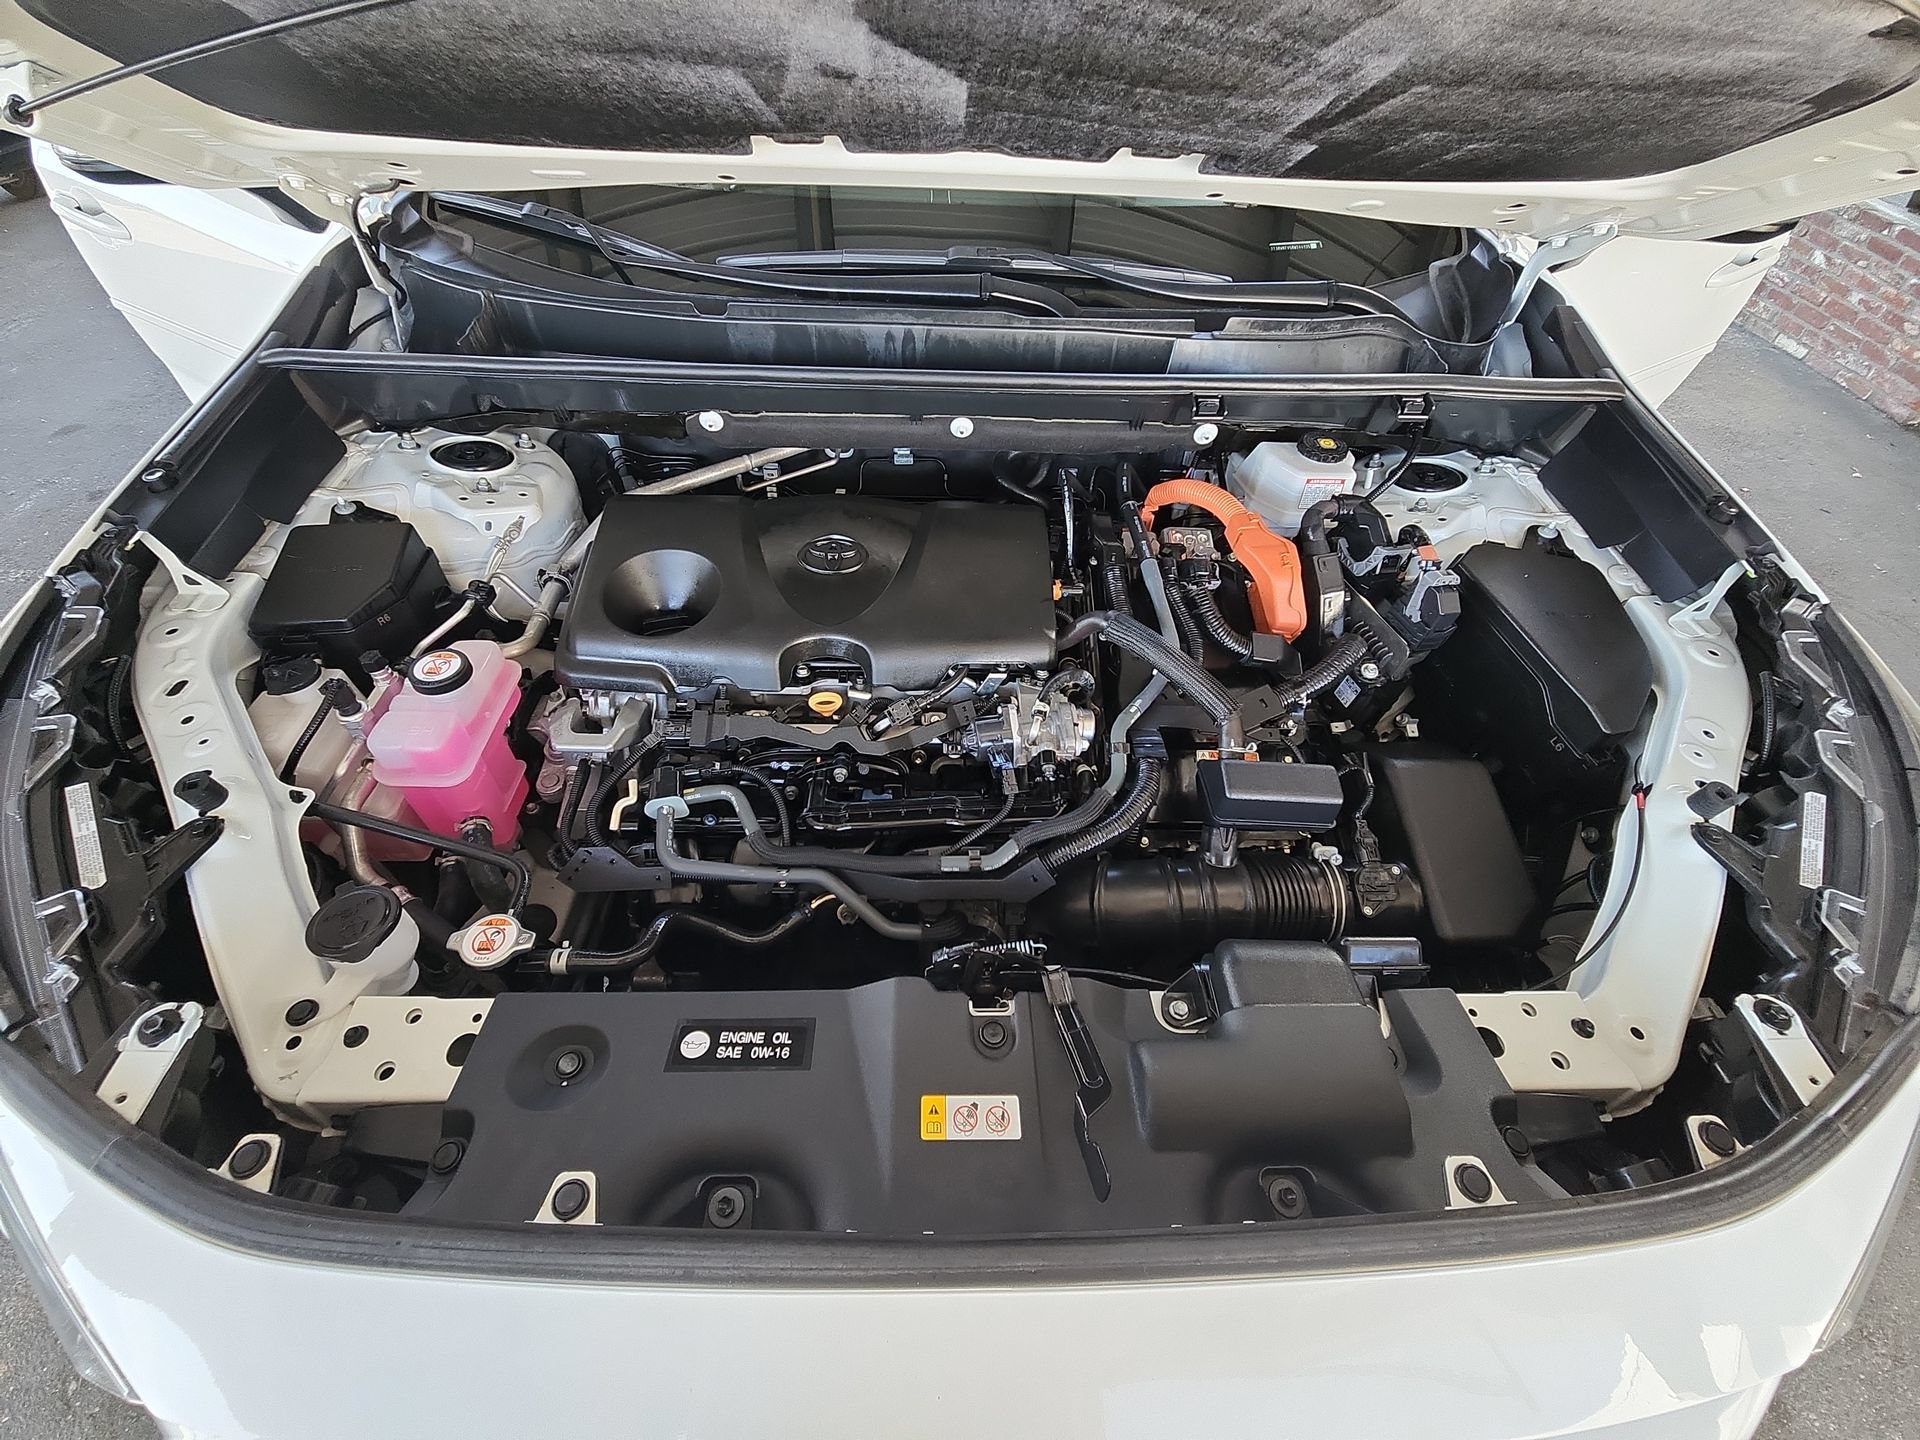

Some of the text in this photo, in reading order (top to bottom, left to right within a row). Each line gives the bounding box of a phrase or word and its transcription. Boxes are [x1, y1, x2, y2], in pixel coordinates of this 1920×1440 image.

[376, 613, 392, 626] R6
[1550, 736, 1565, 751] L6
[719, 1031, 792, 1044] ENGINE OIL
[716, 1046, 790, 1059] SAE 0W-16
